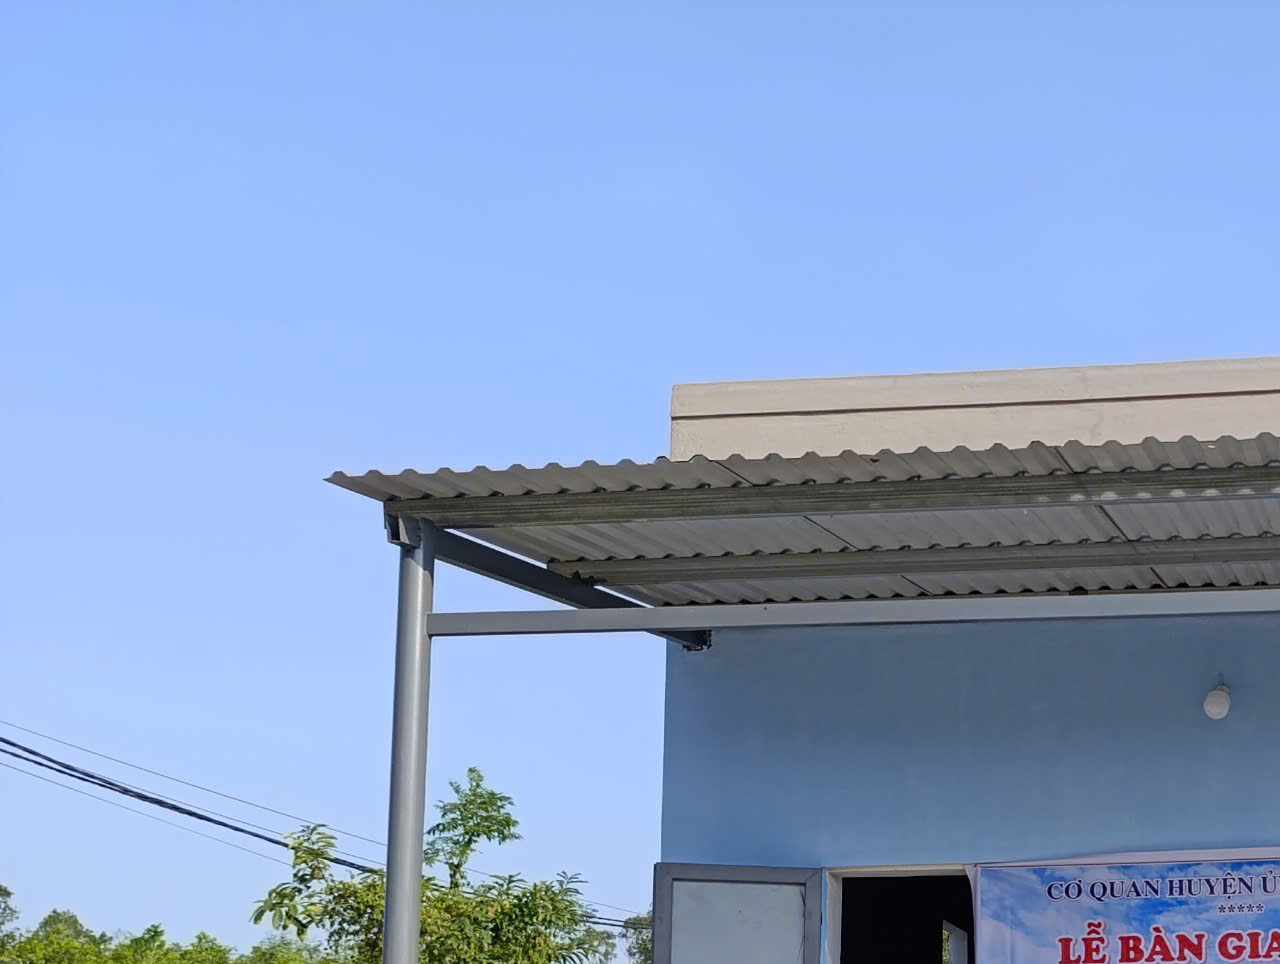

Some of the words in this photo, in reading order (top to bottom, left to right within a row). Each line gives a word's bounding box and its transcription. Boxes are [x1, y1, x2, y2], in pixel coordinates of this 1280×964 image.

[1047, 879, 1082, 900] CƠ
[1090, 879, 1160, 901] QUAN
[1168, 872, 1253, 899] HUYỆN
[1058, 921, 1107, 964] LỄ
[1118, 926, 1206, 964] BÀN
